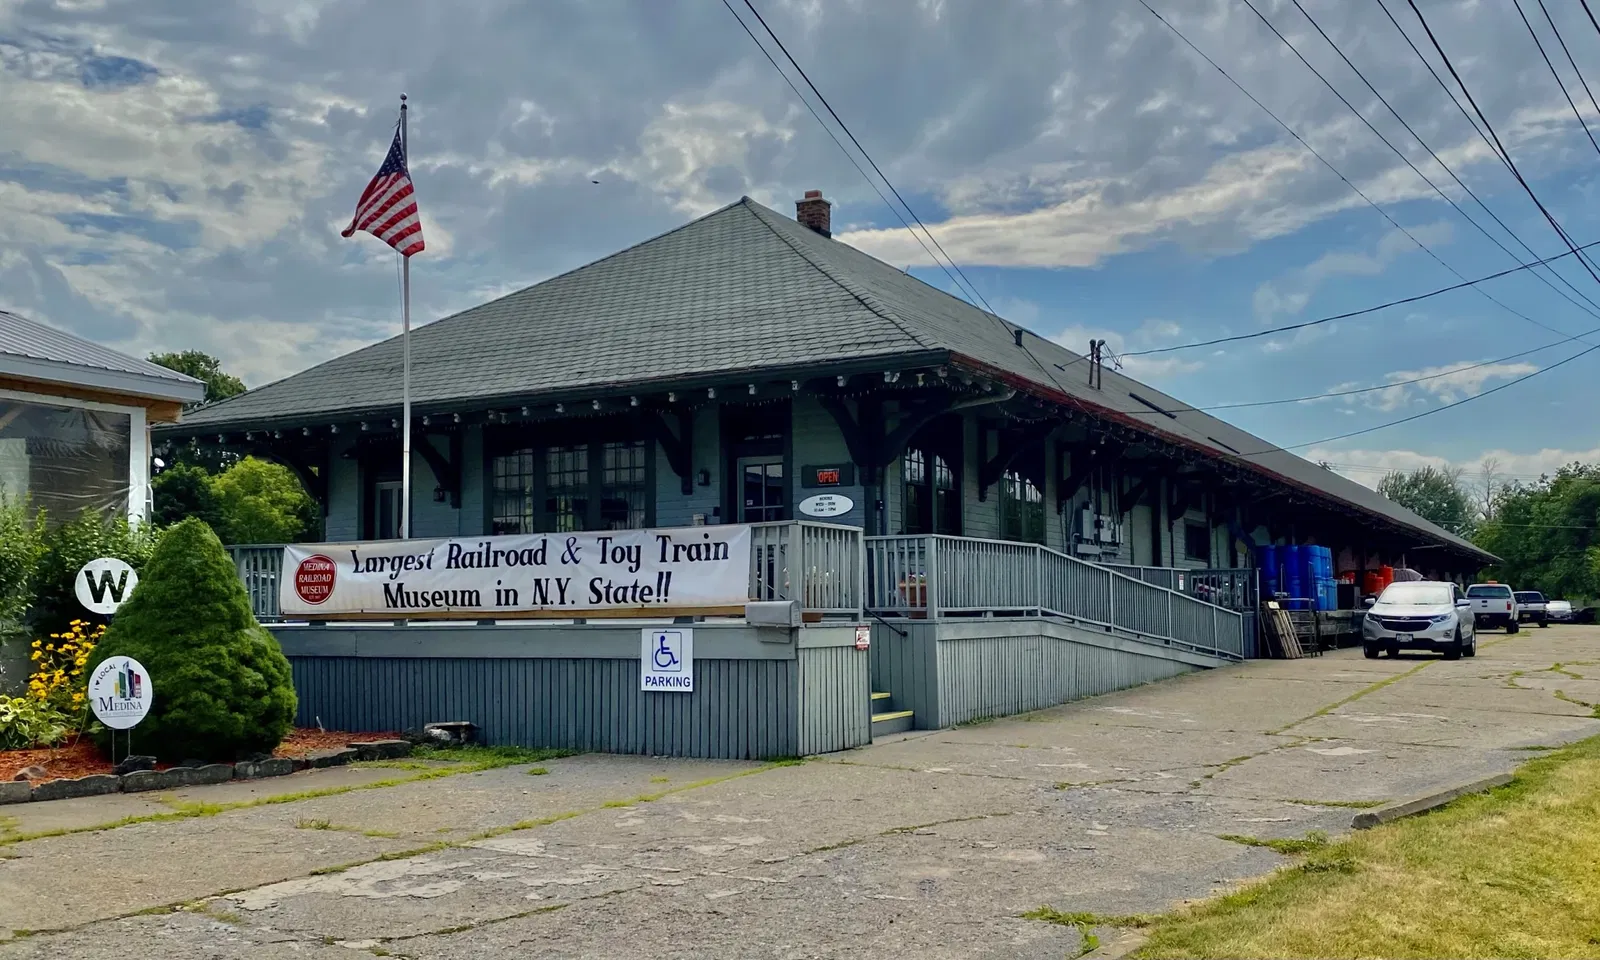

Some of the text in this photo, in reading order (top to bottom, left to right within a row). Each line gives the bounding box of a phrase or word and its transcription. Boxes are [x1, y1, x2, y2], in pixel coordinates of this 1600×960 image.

[818, 471, 838, 483] OPEN
[350, 533, 729, 580] Largest Railroad & Toy Train
[303, 562, 330, 571] MEDINA
[298, 573, 332, 583] RAILROAD
[84, 569, 130, 603] W
[301, 585, 329, 595] MUSEUM
[383, 571, 672, 608] Museum in N.Y. State!!
[98, 663, 116, 680] LOCAL
[645, 676, 691, 687] PARKING
